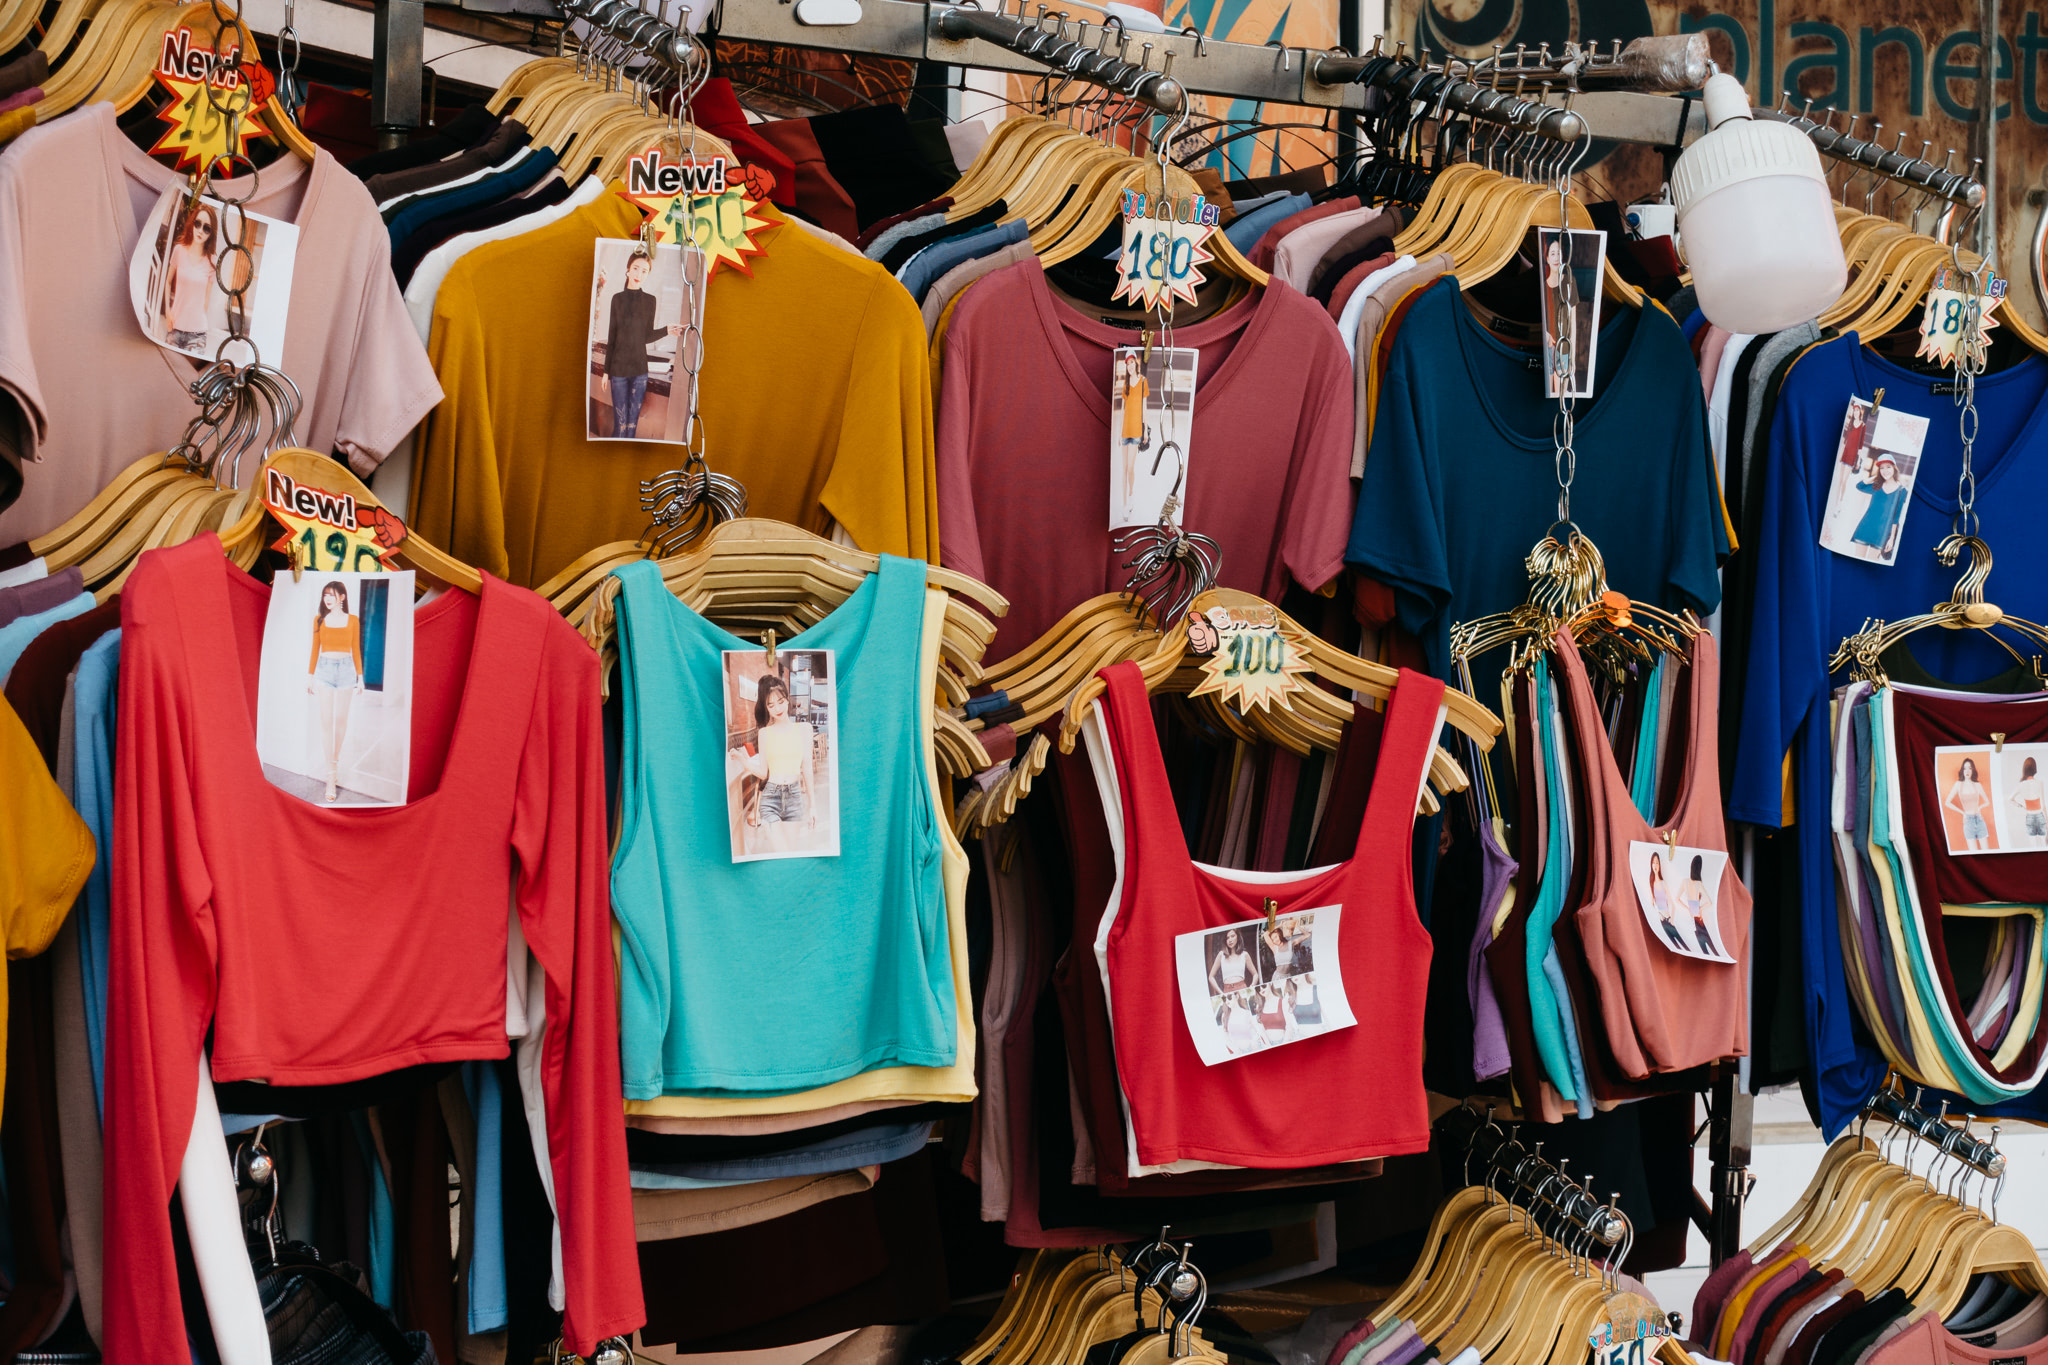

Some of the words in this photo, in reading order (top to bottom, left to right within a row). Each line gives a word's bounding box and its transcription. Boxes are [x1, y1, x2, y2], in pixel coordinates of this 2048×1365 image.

[162, 29, 239, 88] New!
[179, 86, 250, 143] 150
[629, 150, 726, 195] New!
[664, 192, 748, 249] 150
[1177, 193, 1221, 226] offer
[1128, 230, 1193, 281] 180
[267, 468, 358, 531] New!
[300, 527, 383, 572] 190
[1224, 632, 1285, 677] 100
